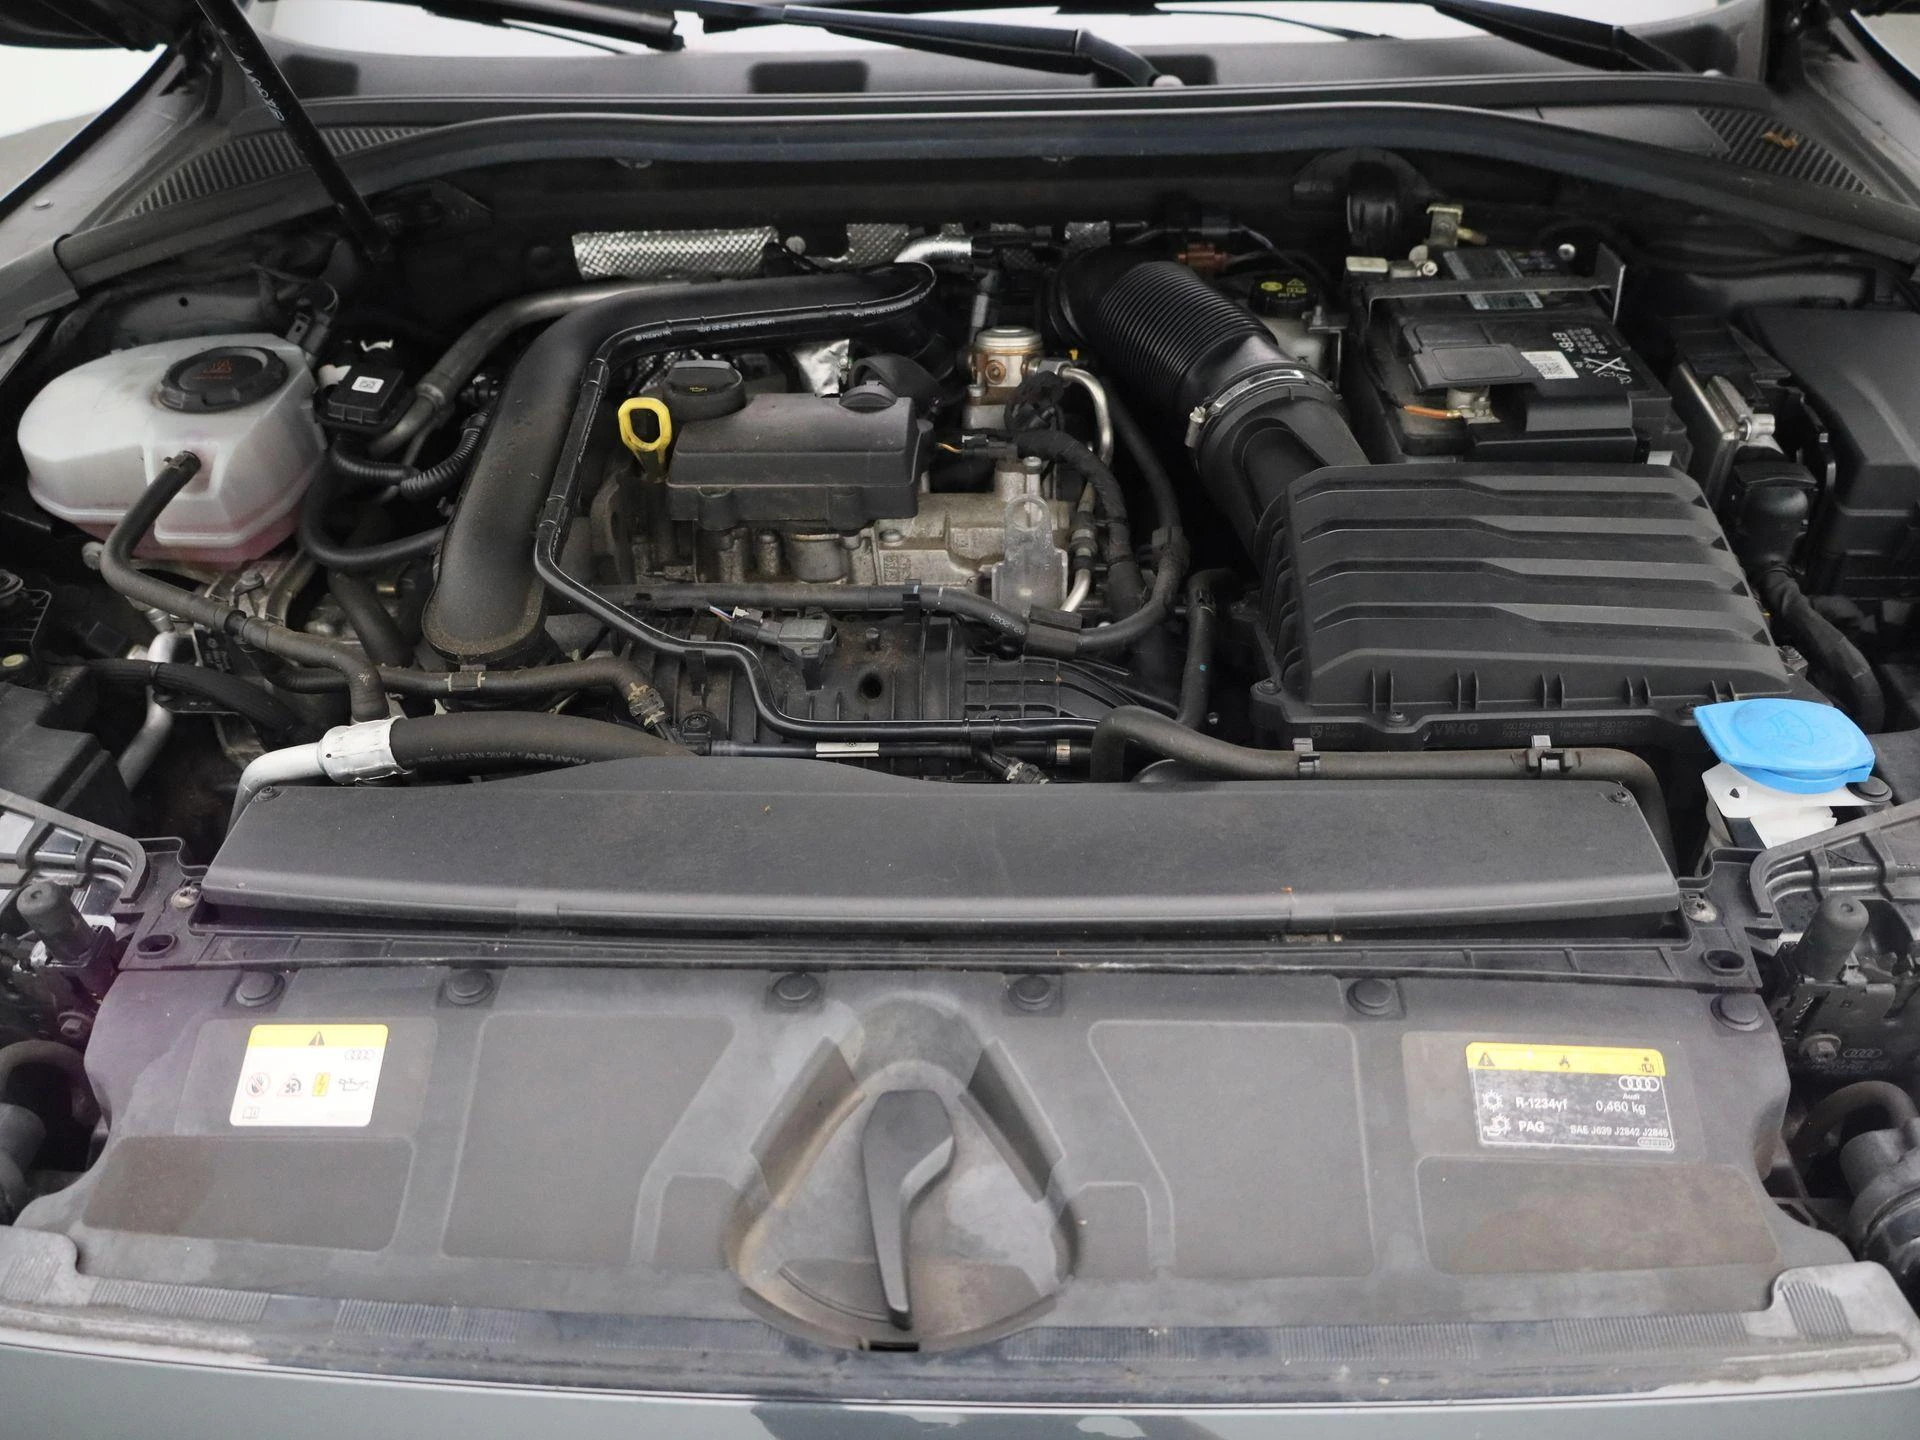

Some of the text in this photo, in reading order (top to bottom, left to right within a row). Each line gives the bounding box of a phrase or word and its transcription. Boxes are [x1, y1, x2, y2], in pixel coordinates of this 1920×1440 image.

[1515, 1098, 1568, 1111] R-1234yf
[1631, 1101, 1646, 1115] kg
[1518, 1120, 1545, 1133] PAG
[1570, 1125, 1588, 1135] SAE
